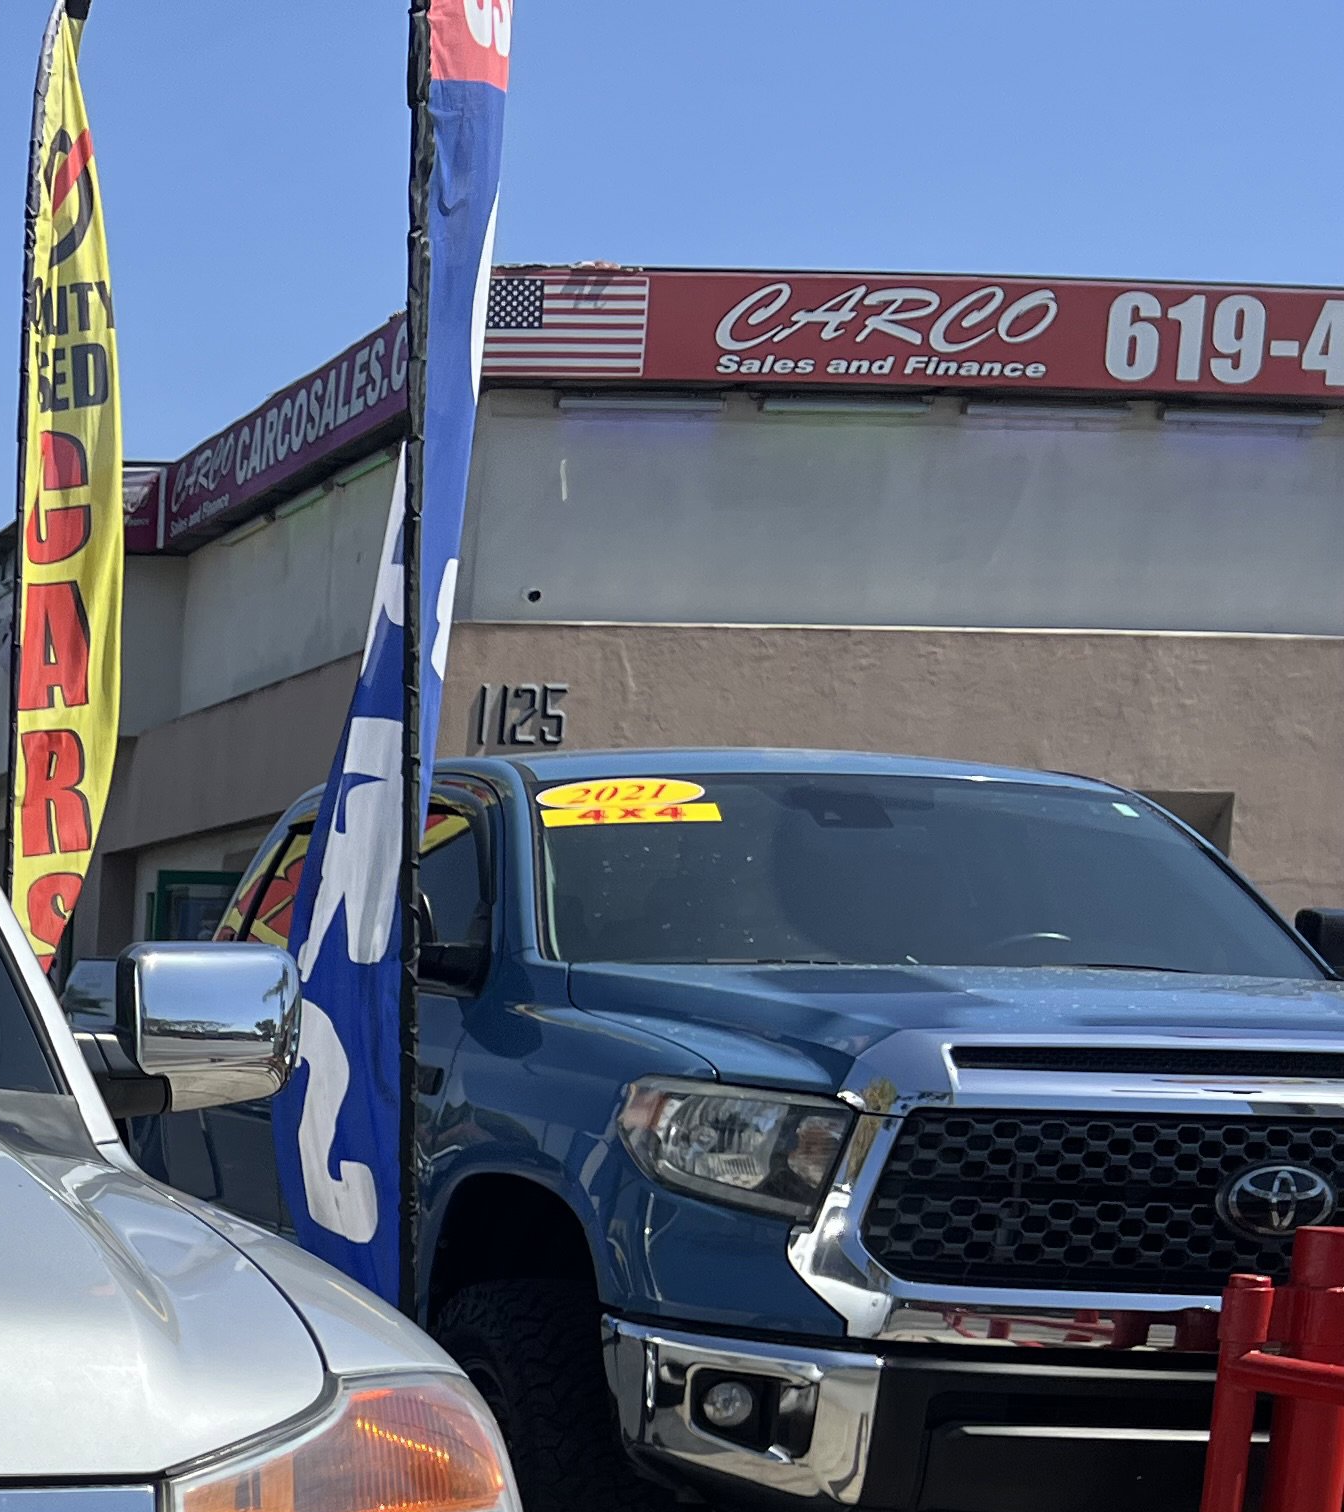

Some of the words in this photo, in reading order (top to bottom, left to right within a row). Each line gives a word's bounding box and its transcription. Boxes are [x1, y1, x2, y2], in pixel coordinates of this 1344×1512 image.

[714, 281, 1058, 353] CARCO
[35, 341, 109, 413] SED
[715, 353, 816, 375] Sales
[826, 354, 898, 376] and
[903, 355, 1048, 379] Finance
[18, 430, 92, 977] CARS
[475, 682, 570, 745] 1125
[566, 782, 670, 805] 2021
